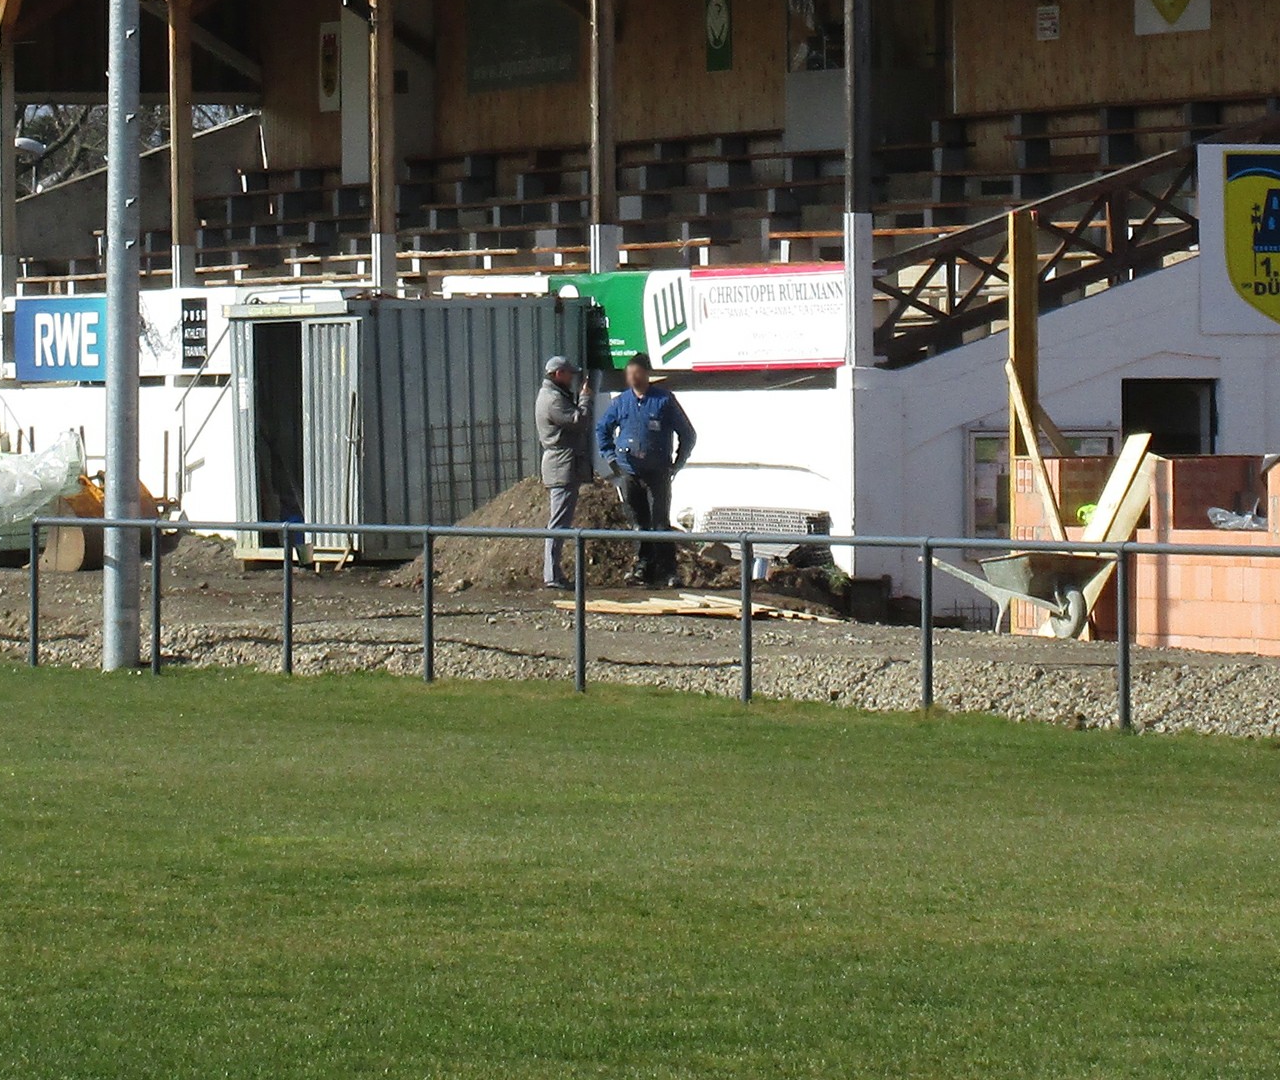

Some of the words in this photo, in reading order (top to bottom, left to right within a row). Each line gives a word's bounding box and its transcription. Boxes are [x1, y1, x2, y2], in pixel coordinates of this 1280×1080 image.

[1261, 257, 1279, 277] 1.
[709, 283, 776, 304] CHRISTOPH
[779, 279, 844, 302] RÜHLMANN
[184, 310, 206, 321] PUSH
[35, 312, 99, 367] RWE
